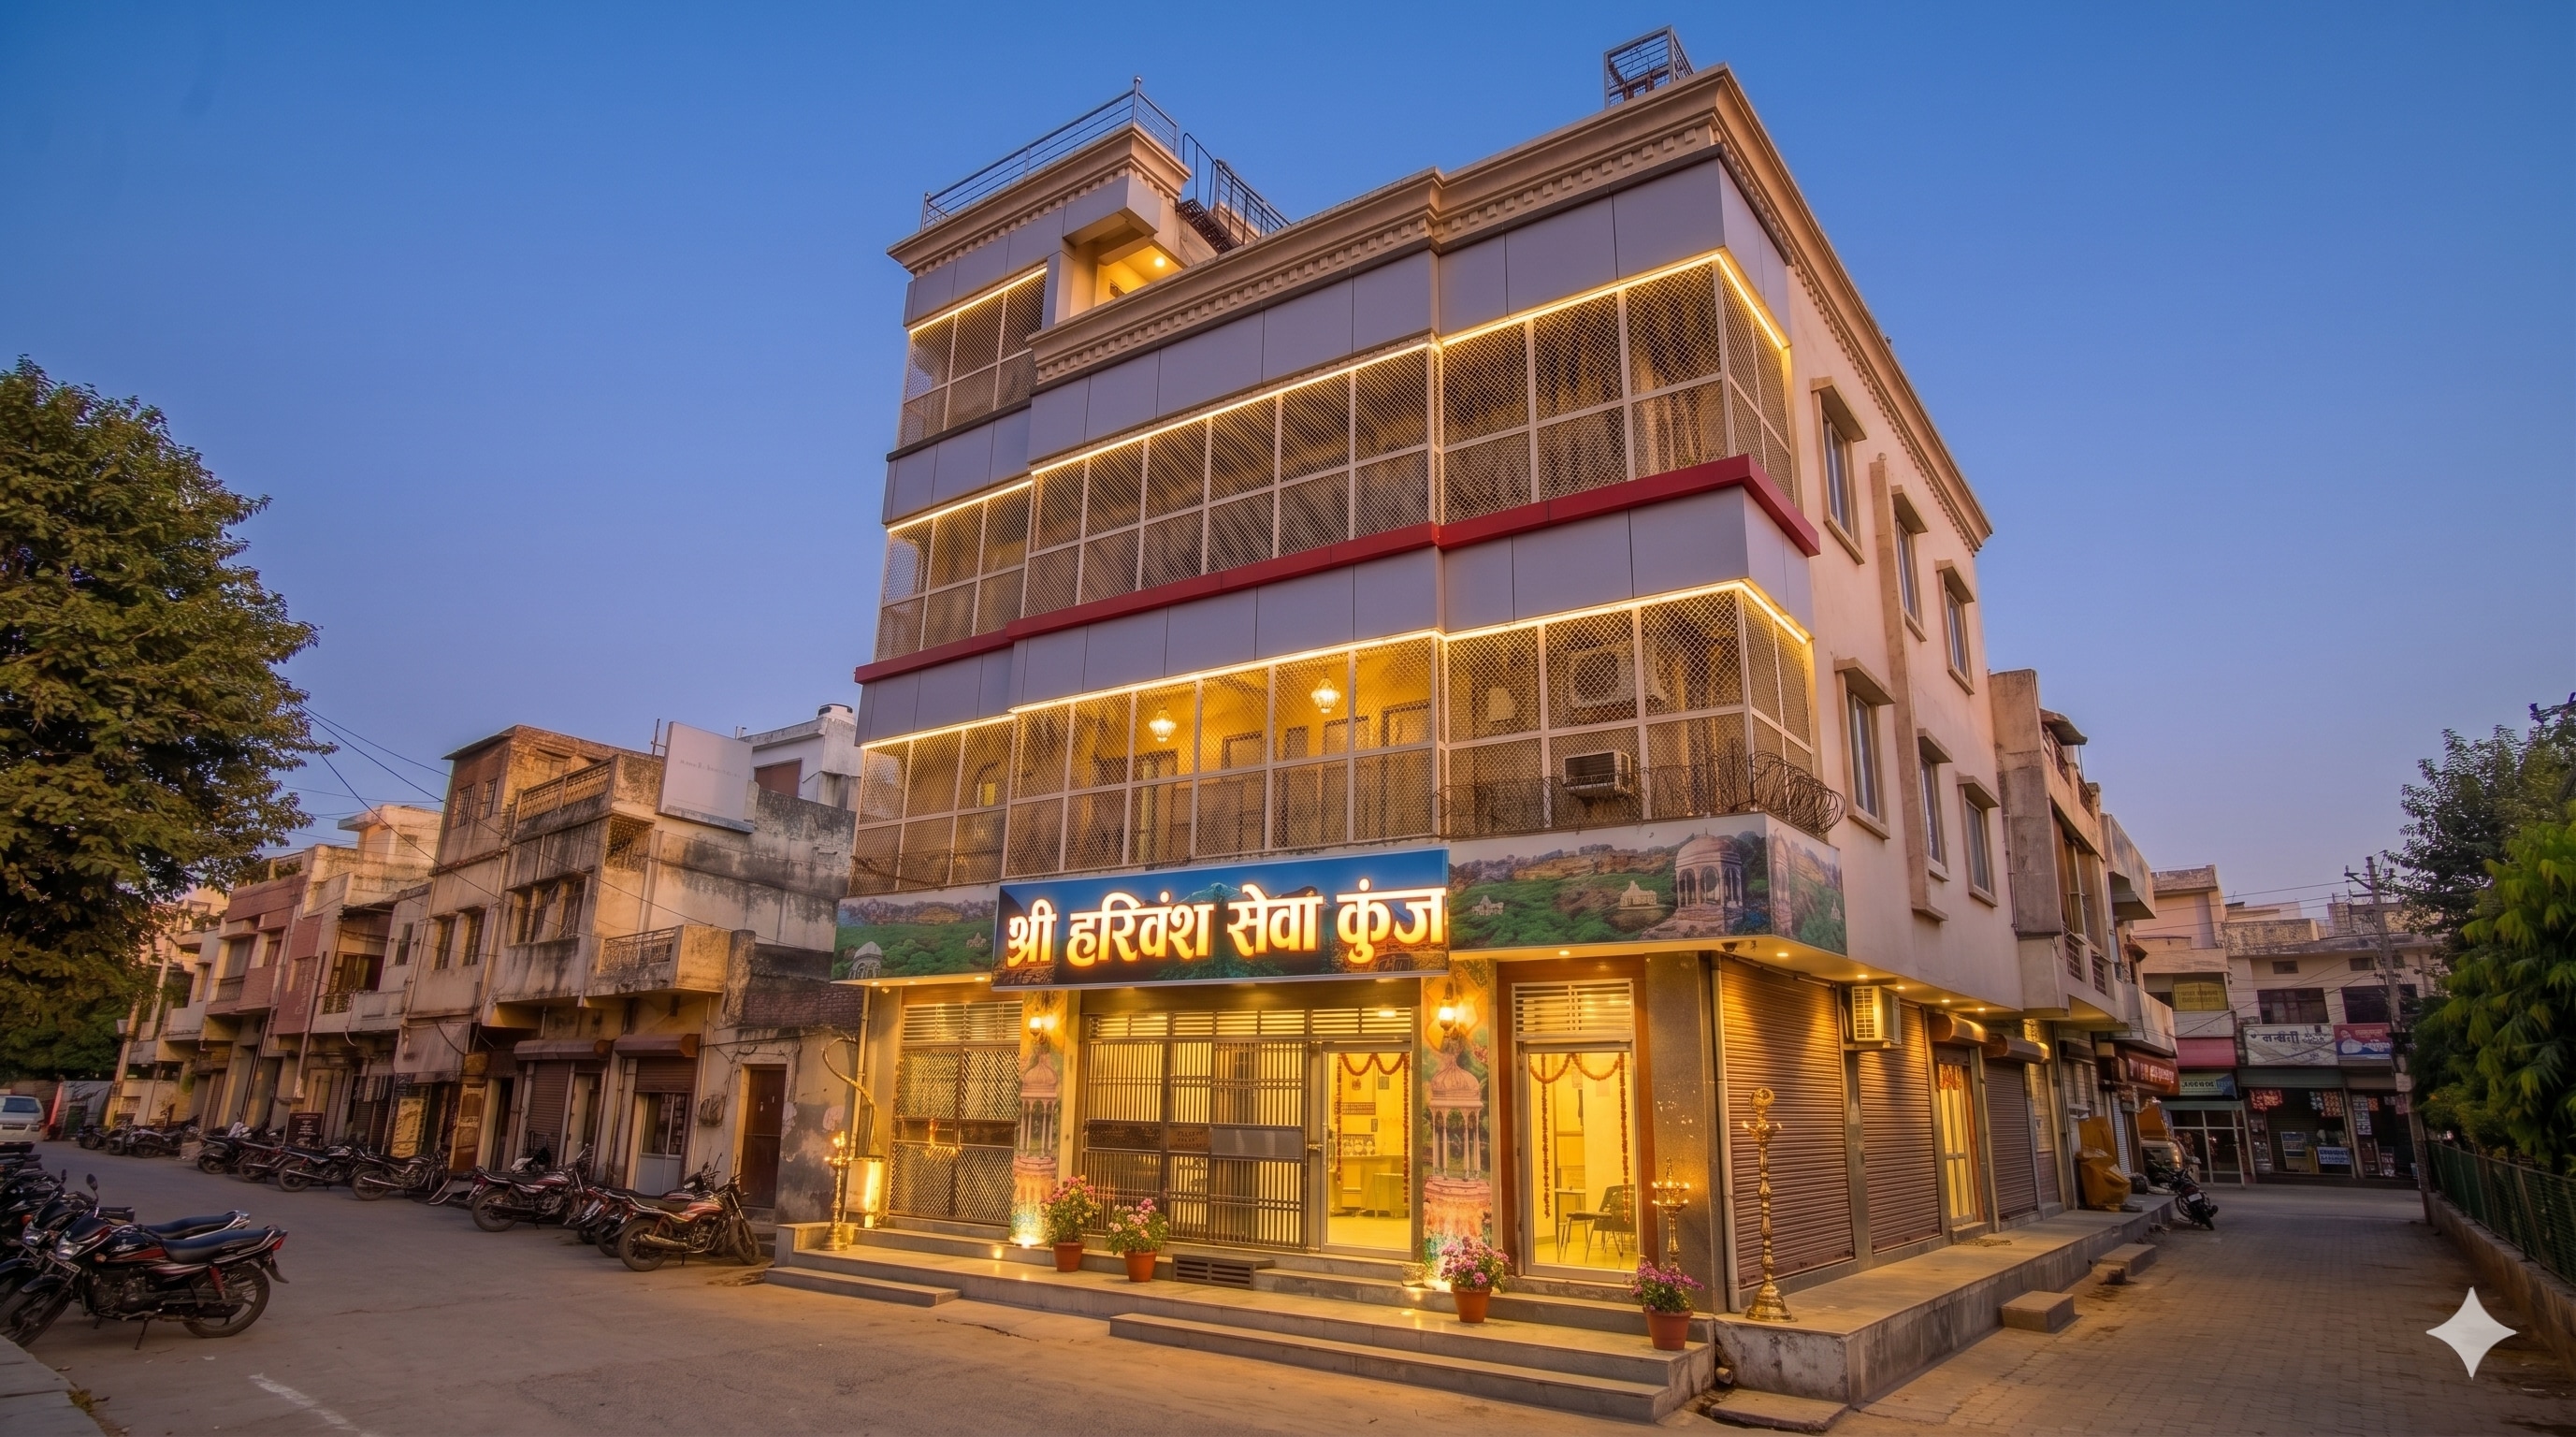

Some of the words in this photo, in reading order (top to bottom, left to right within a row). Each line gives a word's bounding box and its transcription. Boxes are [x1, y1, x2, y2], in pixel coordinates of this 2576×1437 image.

[1006, 898, 1058, 967] श्री
[1066, 891, 1215, 967] हरिवंश
[1226, 883, 1324, 957] सेवा
[1336, 878, 1448, 965] कुंज
